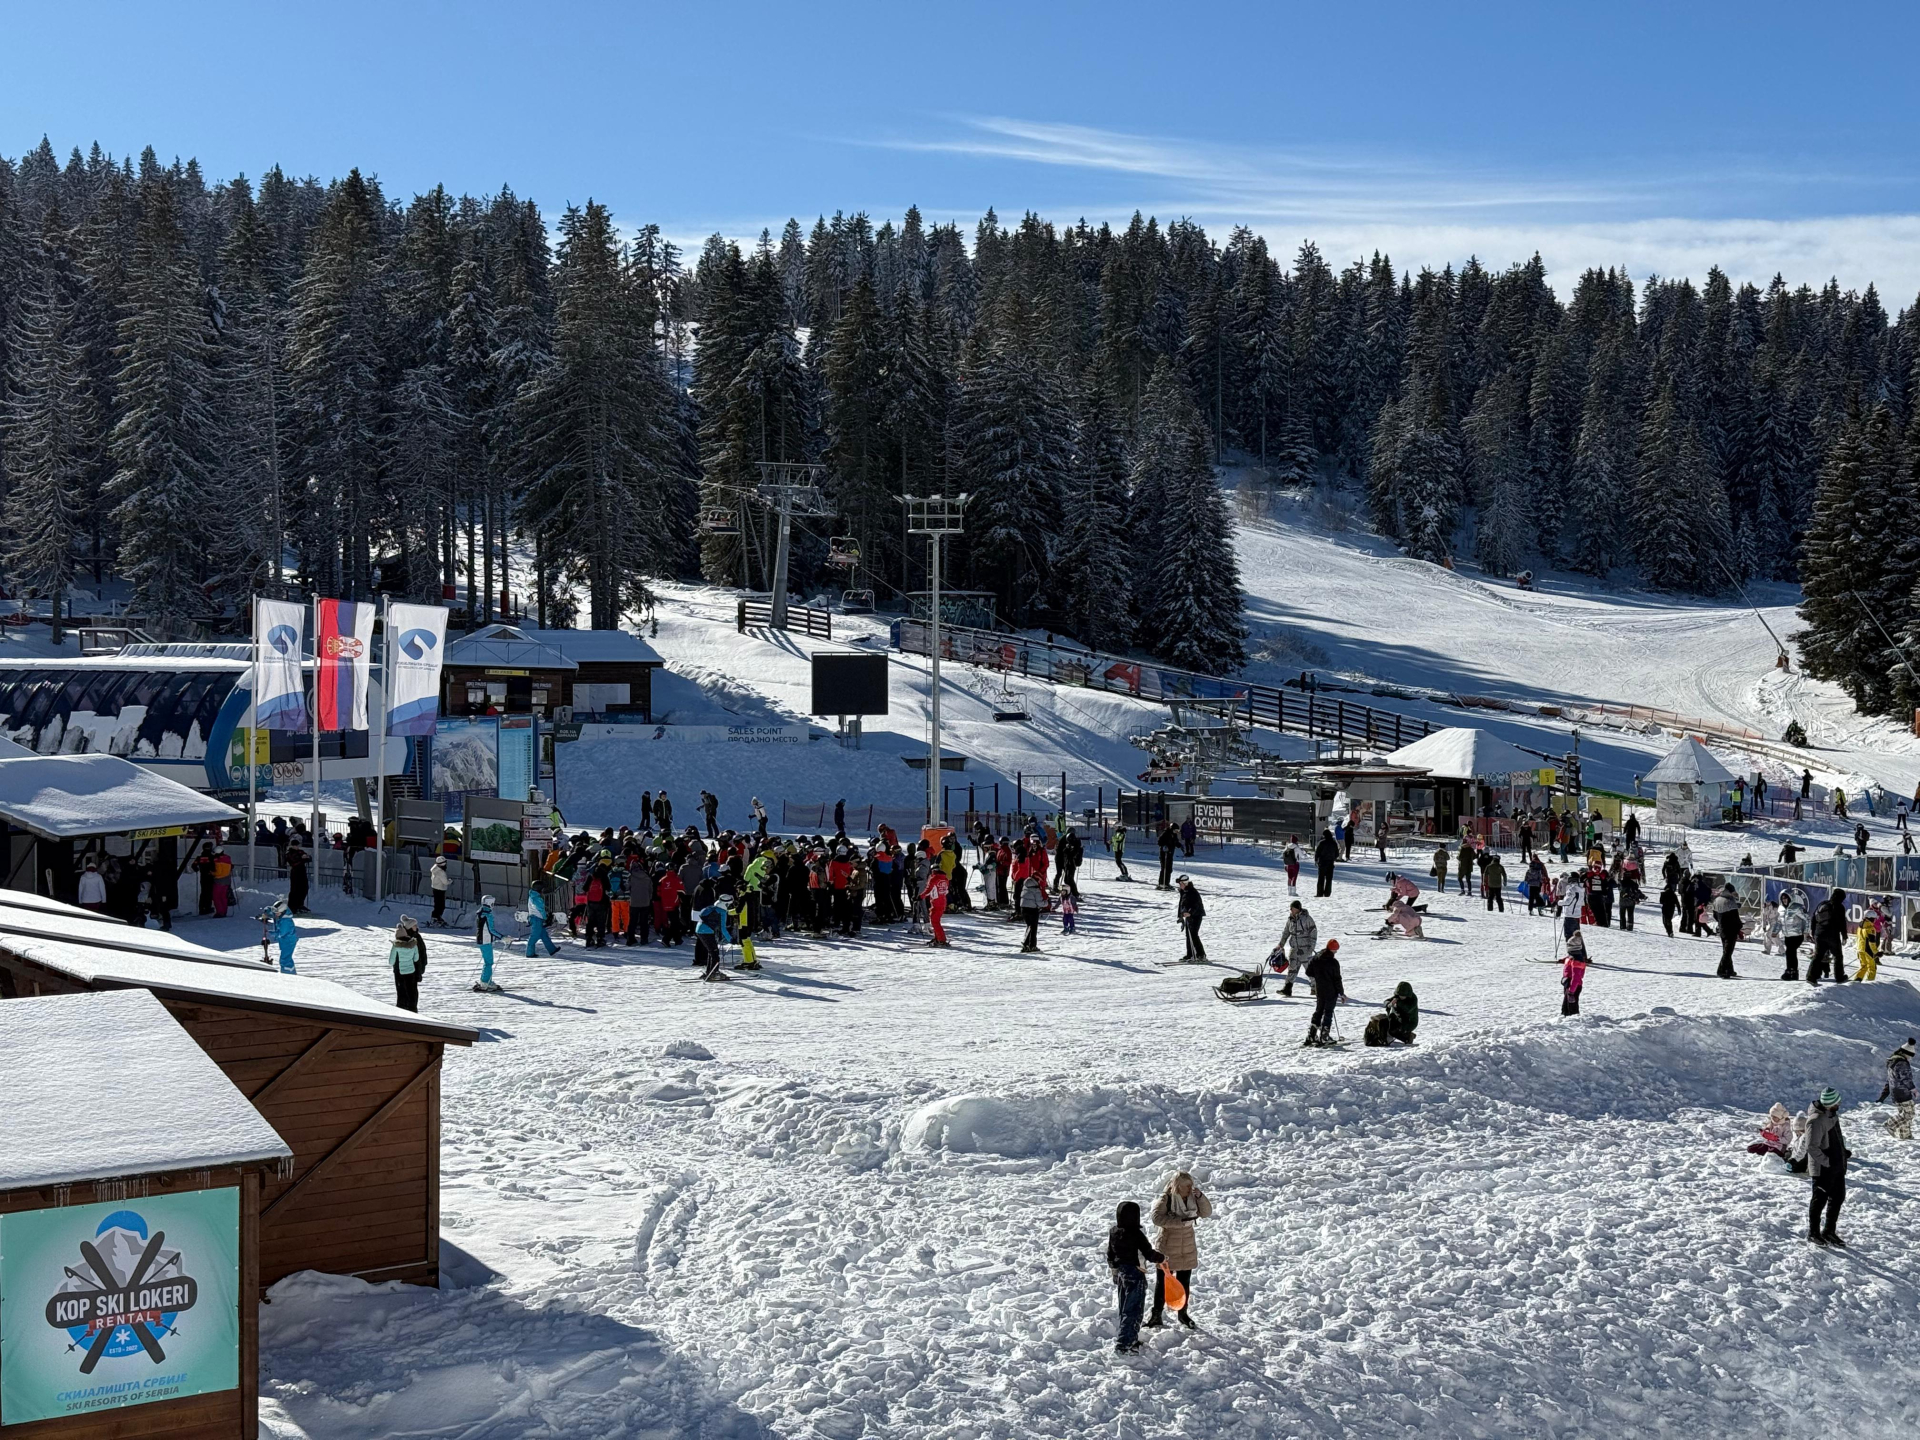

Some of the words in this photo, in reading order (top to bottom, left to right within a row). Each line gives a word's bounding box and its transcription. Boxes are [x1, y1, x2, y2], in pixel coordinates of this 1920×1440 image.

[727, 727, 755, 735] SALES
[757, 727, 783, 735] POINT
[136, 830, 148, 838] SKI
[150, 828, 167, 836] PASS
[56, 1298, 90, 1322] KOP
[96, 1293, 124, 1316] SKI
[130, 1283, 189, 1312] LOKERI
[96, 1311, 154, 1329] RENTAL
[56, 1380, 140, 1402] СКИЈАЛИШТА
[143, 1373, 188, 1389] СРБИЈЕ
[66, 1401, 82, 1411] SKI
[84, 1394, 128, 1409] RESORTS
[130, 1391, 143, 1401] OF
[145, 1386, 180, 1399] SERBIA
